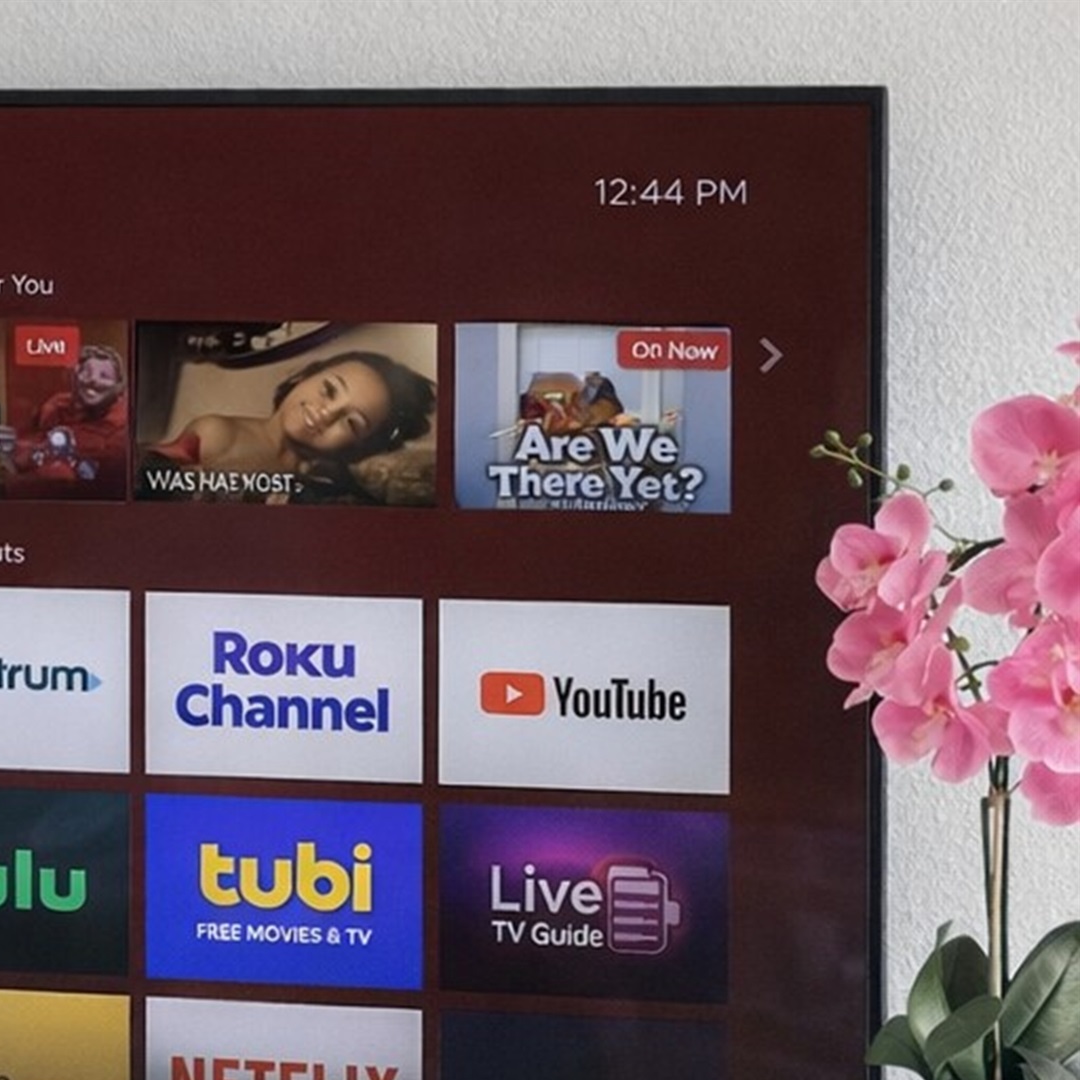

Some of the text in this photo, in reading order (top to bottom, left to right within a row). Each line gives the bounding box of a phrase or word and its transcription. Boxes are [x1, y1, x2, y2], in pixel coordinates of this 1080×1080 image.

[594, 177, 747, 206] 12:44 PM
[11, 274, 54, 295] You
[631, 340, 719, 360] On Now
[515, 424, 679, 463] Are We
[488, 465, 704, 500] There Yet?
[213, 631, 356, 679] Roku
[175, 683, 390, 733] Channel
[553, 676, 687, 721] YouTube
[199, 841, 372, 913] tubi
[491, 863, 603, 914] Live
[196, 922, 373, 946] FREE MOVIES & TV
[491, 920, 604, 948] TV Guide
